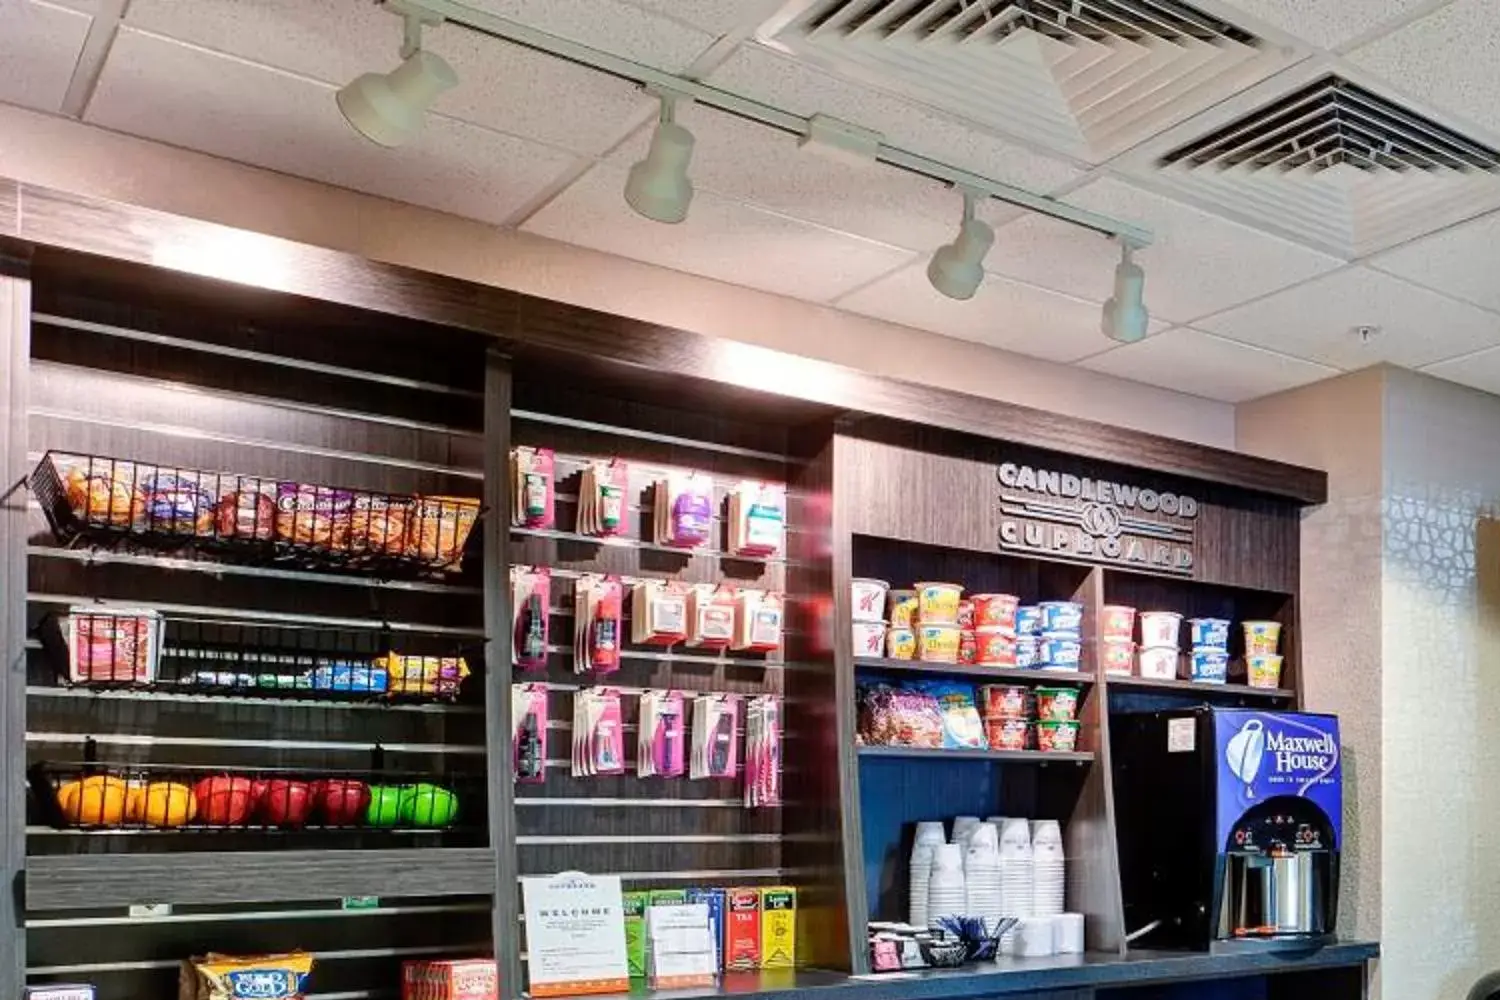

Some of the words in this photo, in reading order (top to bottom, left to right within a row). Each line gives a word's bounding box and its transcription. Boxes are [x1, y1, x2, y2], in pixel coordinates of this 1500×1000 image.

[998, 463, 1197, 518] CANDLEWOOD
[1000, 521, 1193, 568] CUPBOARD
[1266, 729, 1335, 754] Maxwell
[1275, 751, 1329, 773] House
